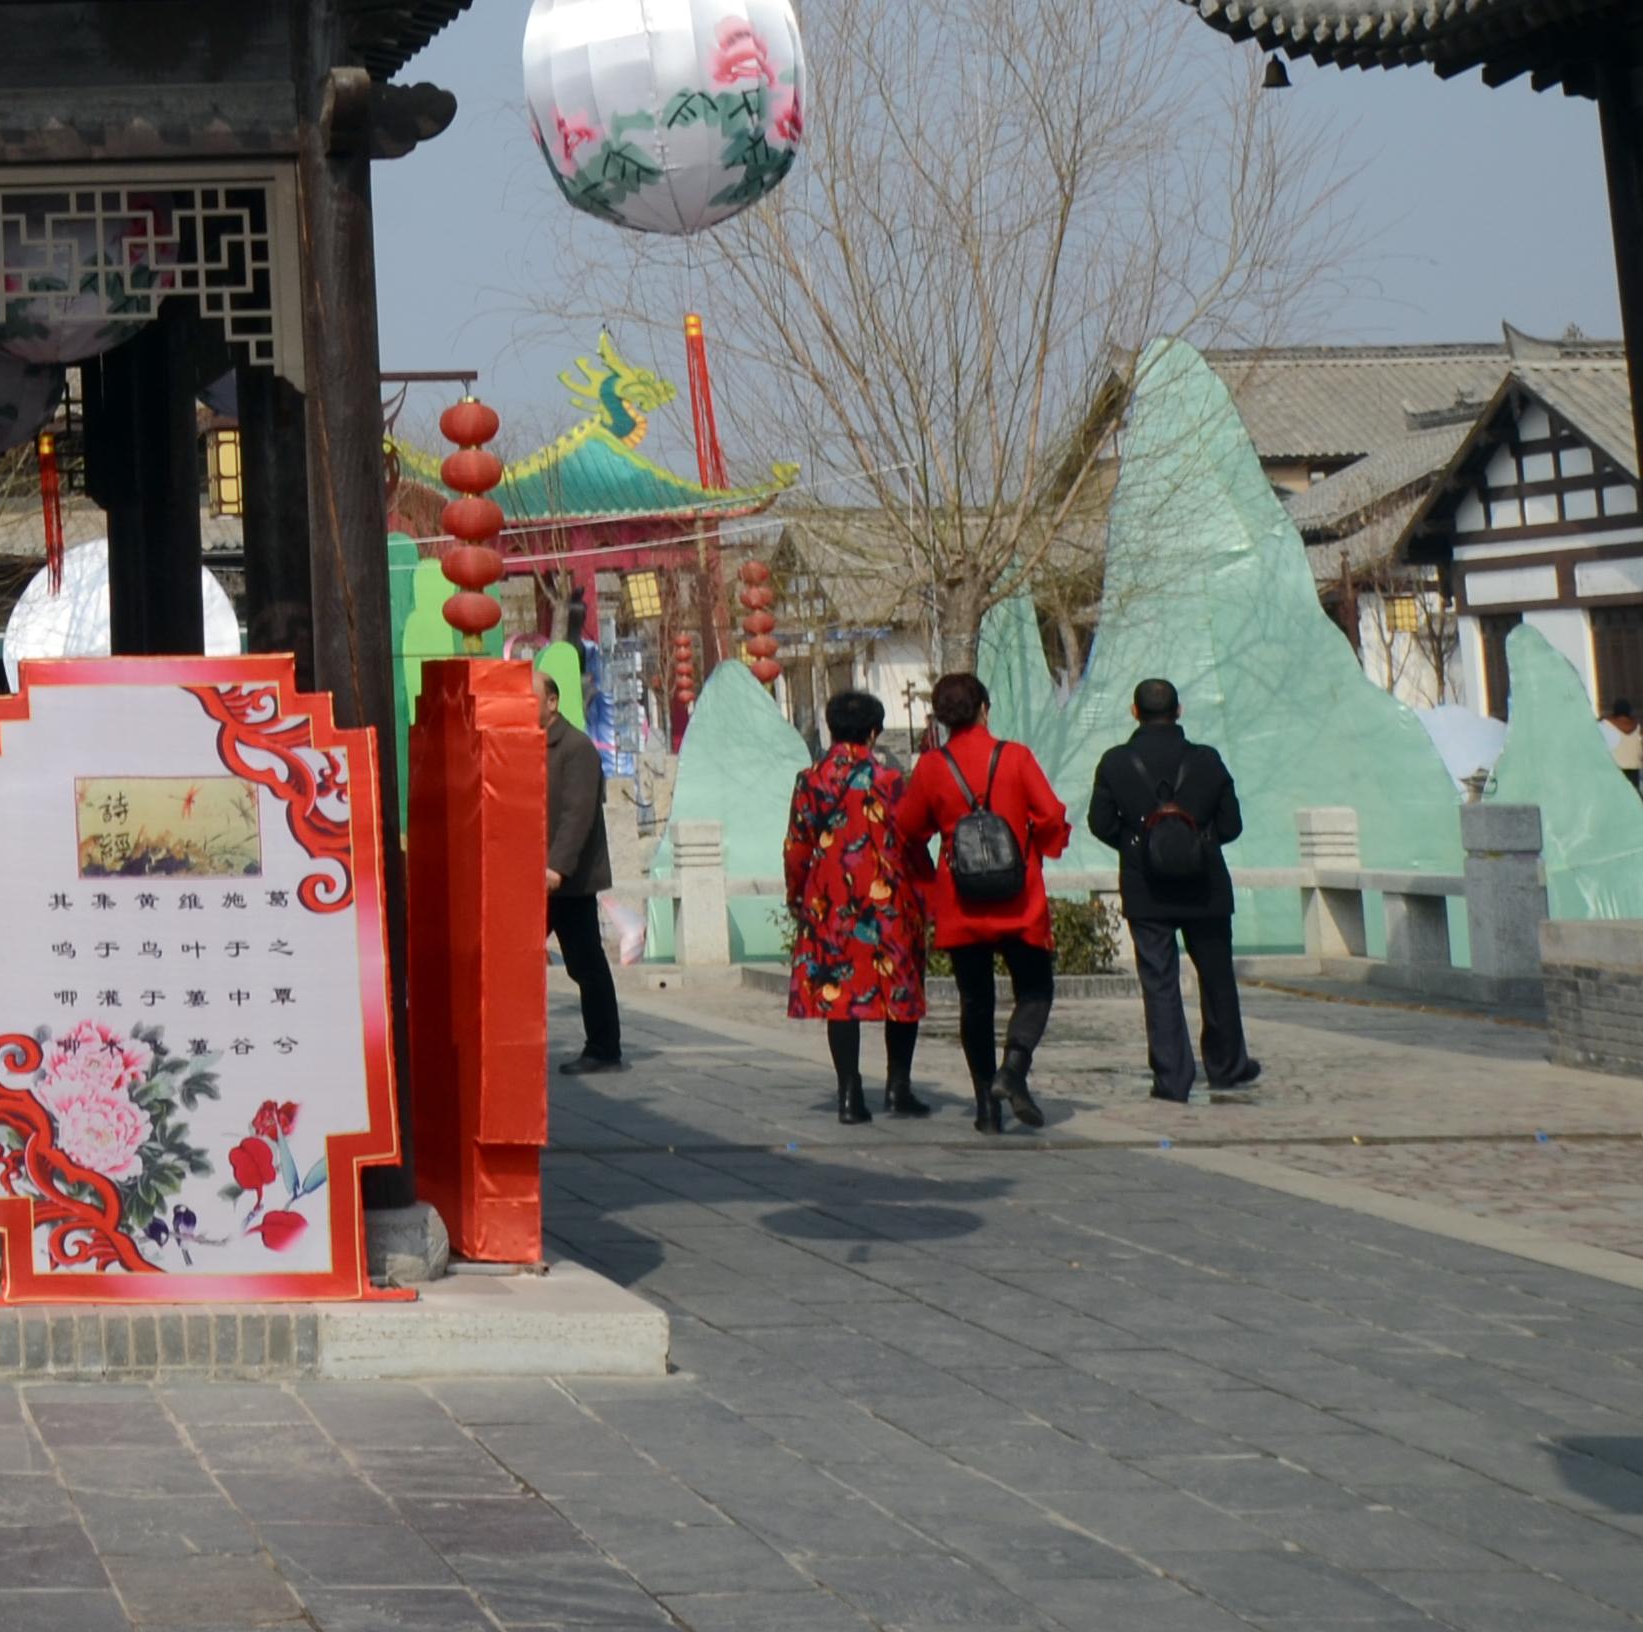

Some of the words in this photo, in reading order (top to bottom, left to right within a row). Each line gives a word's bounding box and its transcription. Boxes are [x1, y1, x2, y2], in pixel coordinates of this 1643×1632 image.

[221, 891, 255, 1056] 施于中谷
[265, 889, 299, 1056] 葛之覃兮
